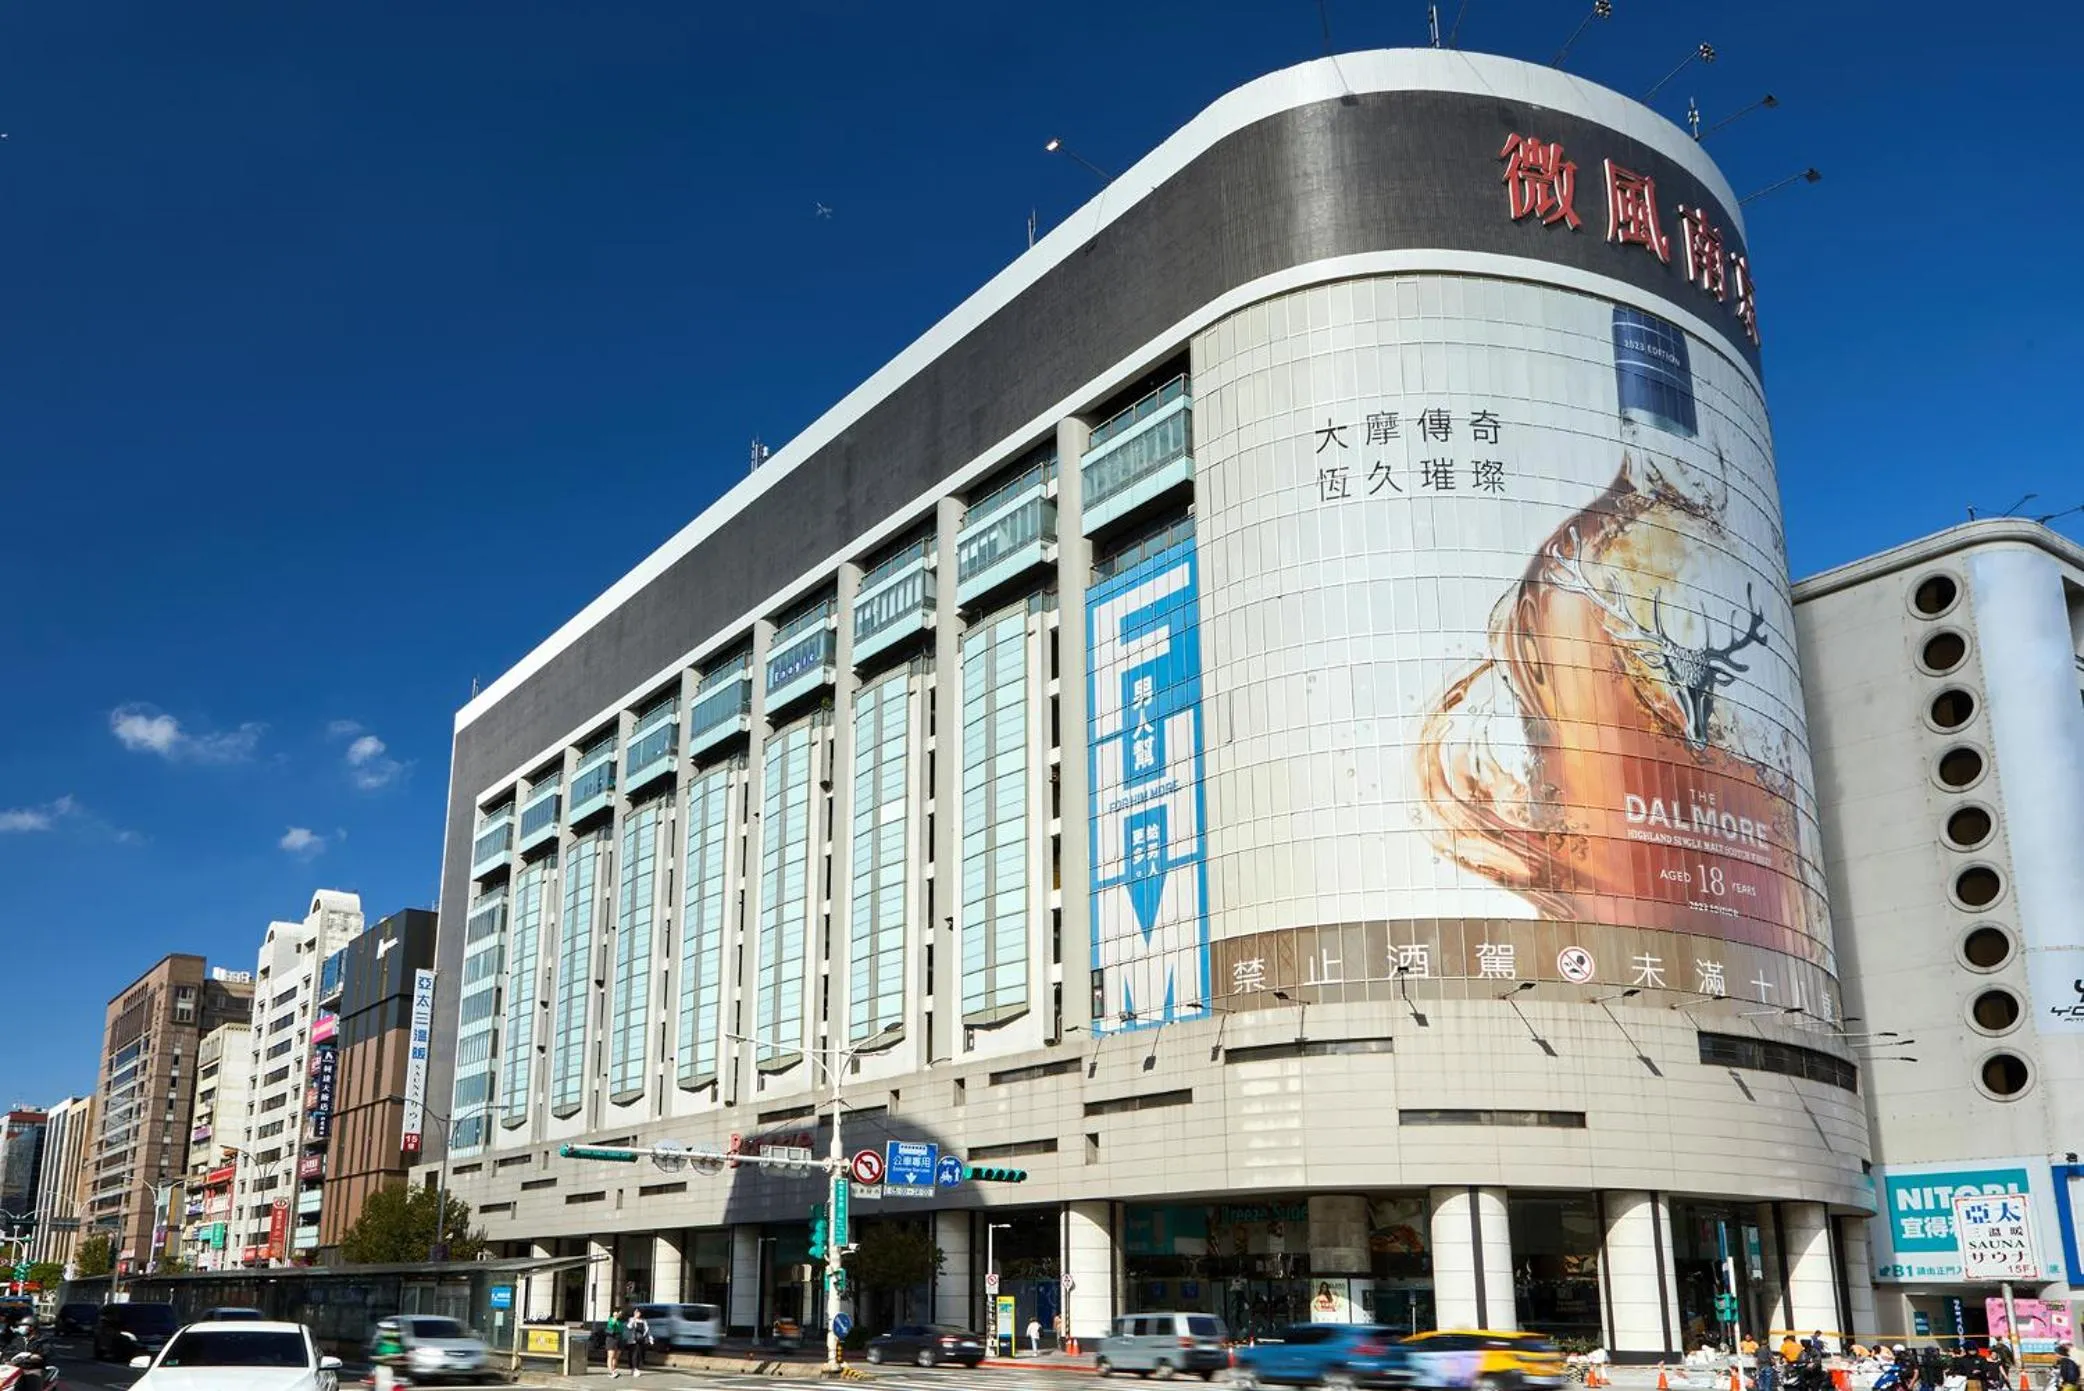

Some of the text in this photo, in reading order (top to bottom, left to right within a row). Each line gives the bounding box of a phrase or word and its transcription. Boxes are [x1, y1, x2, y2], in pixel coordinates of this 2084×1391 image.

[1315, 407, 1502, 454] 大摩傳奇
[1690, 788, 1716, 805] THE
[1624, 793, 1769, 850] DALMORE
[1660, 869, 1692, 883] AGED
[1697, 864, 1726, 896] 18
[1232, 943, 1517, 994] 禁止酒駕
[1965, 1202, 2022, 1224] 亞太
[1968, 1240, 2025, 1249] SAUNA
[1893, 1265, 1912, 1277] B1
[2008, 1264, 2030, 1274] 15F
